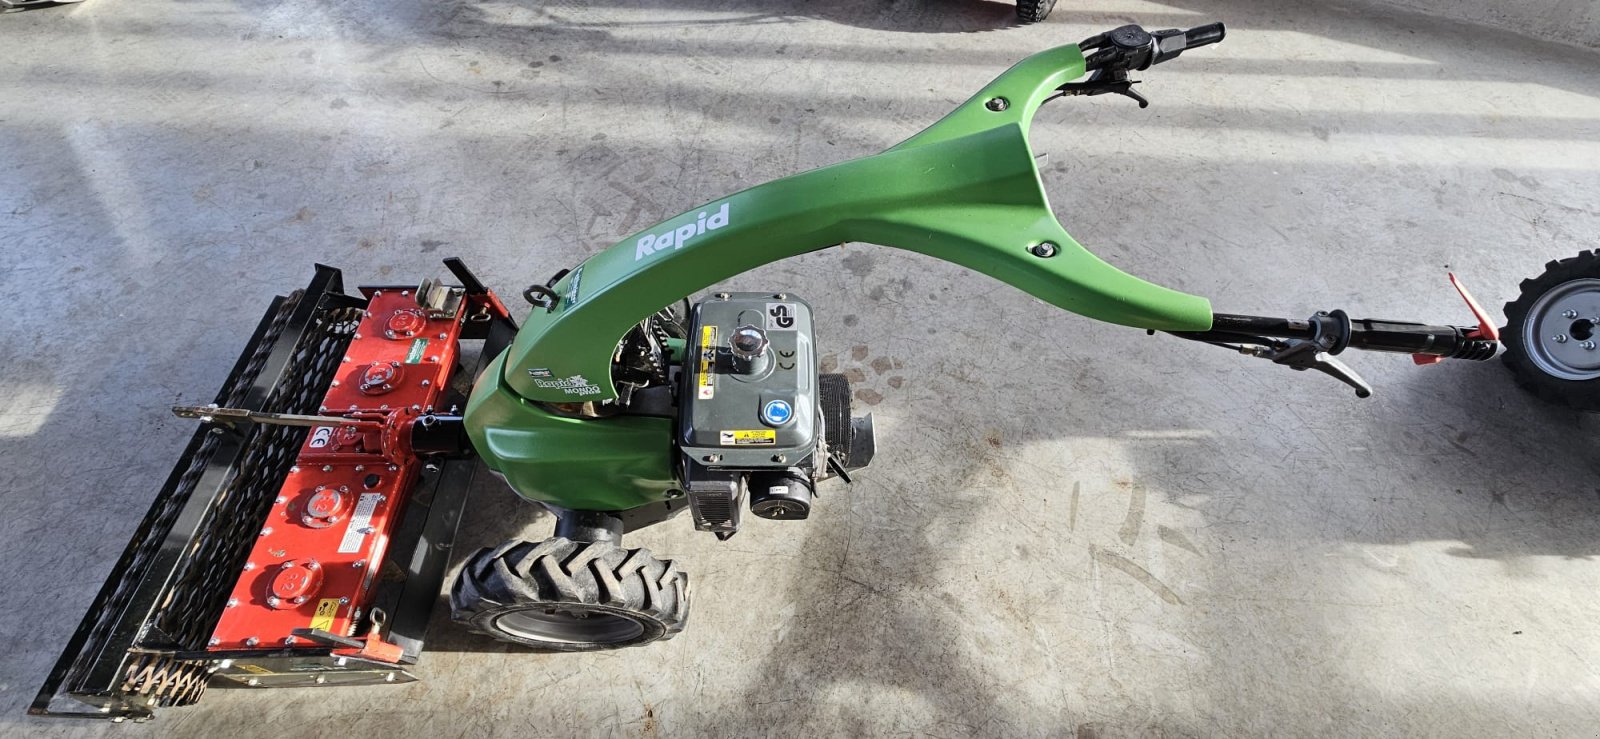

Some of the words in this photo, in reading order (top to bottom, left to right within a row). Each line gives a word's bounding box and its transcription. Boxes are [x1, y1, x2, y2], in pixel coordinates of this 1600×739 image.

[635, 202, 730, 262] Rapid
[769, 304, 794, 328] GS
[534, 377, 573, 390] Rapid
[564, 385, 600, 394] MONDO
[311, 428, 330, 446] CE
